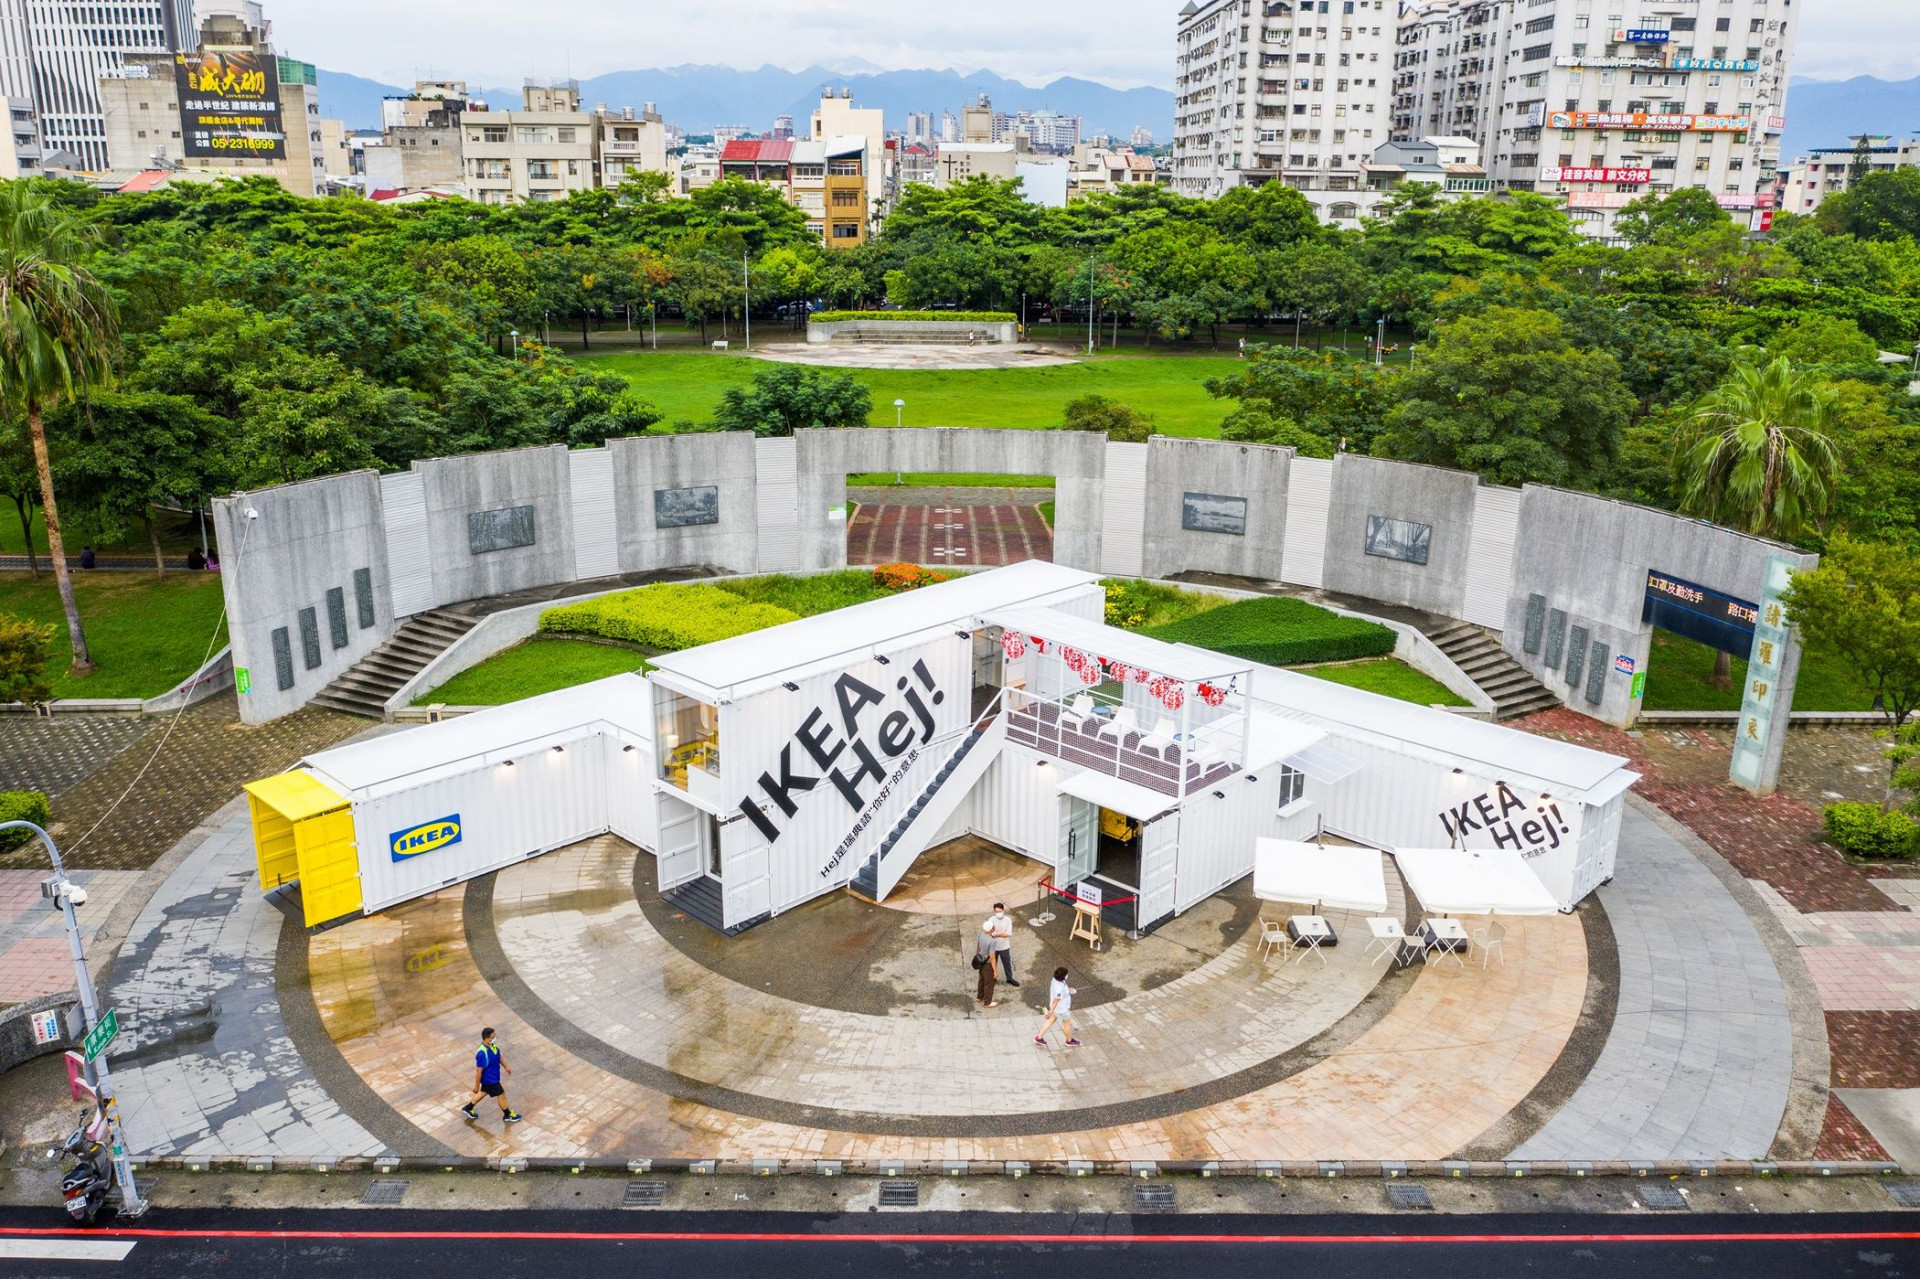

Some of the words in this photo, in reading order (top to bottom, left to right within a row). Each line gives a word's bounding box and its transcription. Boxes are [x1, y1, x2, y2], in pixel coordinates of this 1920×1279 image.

[211, 138, 275, 149] 05-2316999
[1563, 169, 1604, 180] 佳音英語
[1606, 169, 1648, 181] 崇文分校
[1648, 575, 1704, 604] 口罩及勤洗手
[828, 657, 944, 814] Hej!
[738, 672, 886, 844] IKEA
[1438, 785, 1527, 840] IKEA
[1490, 803, 1569, 850] Hej!
[399, 825, 455, 851] IKEA
